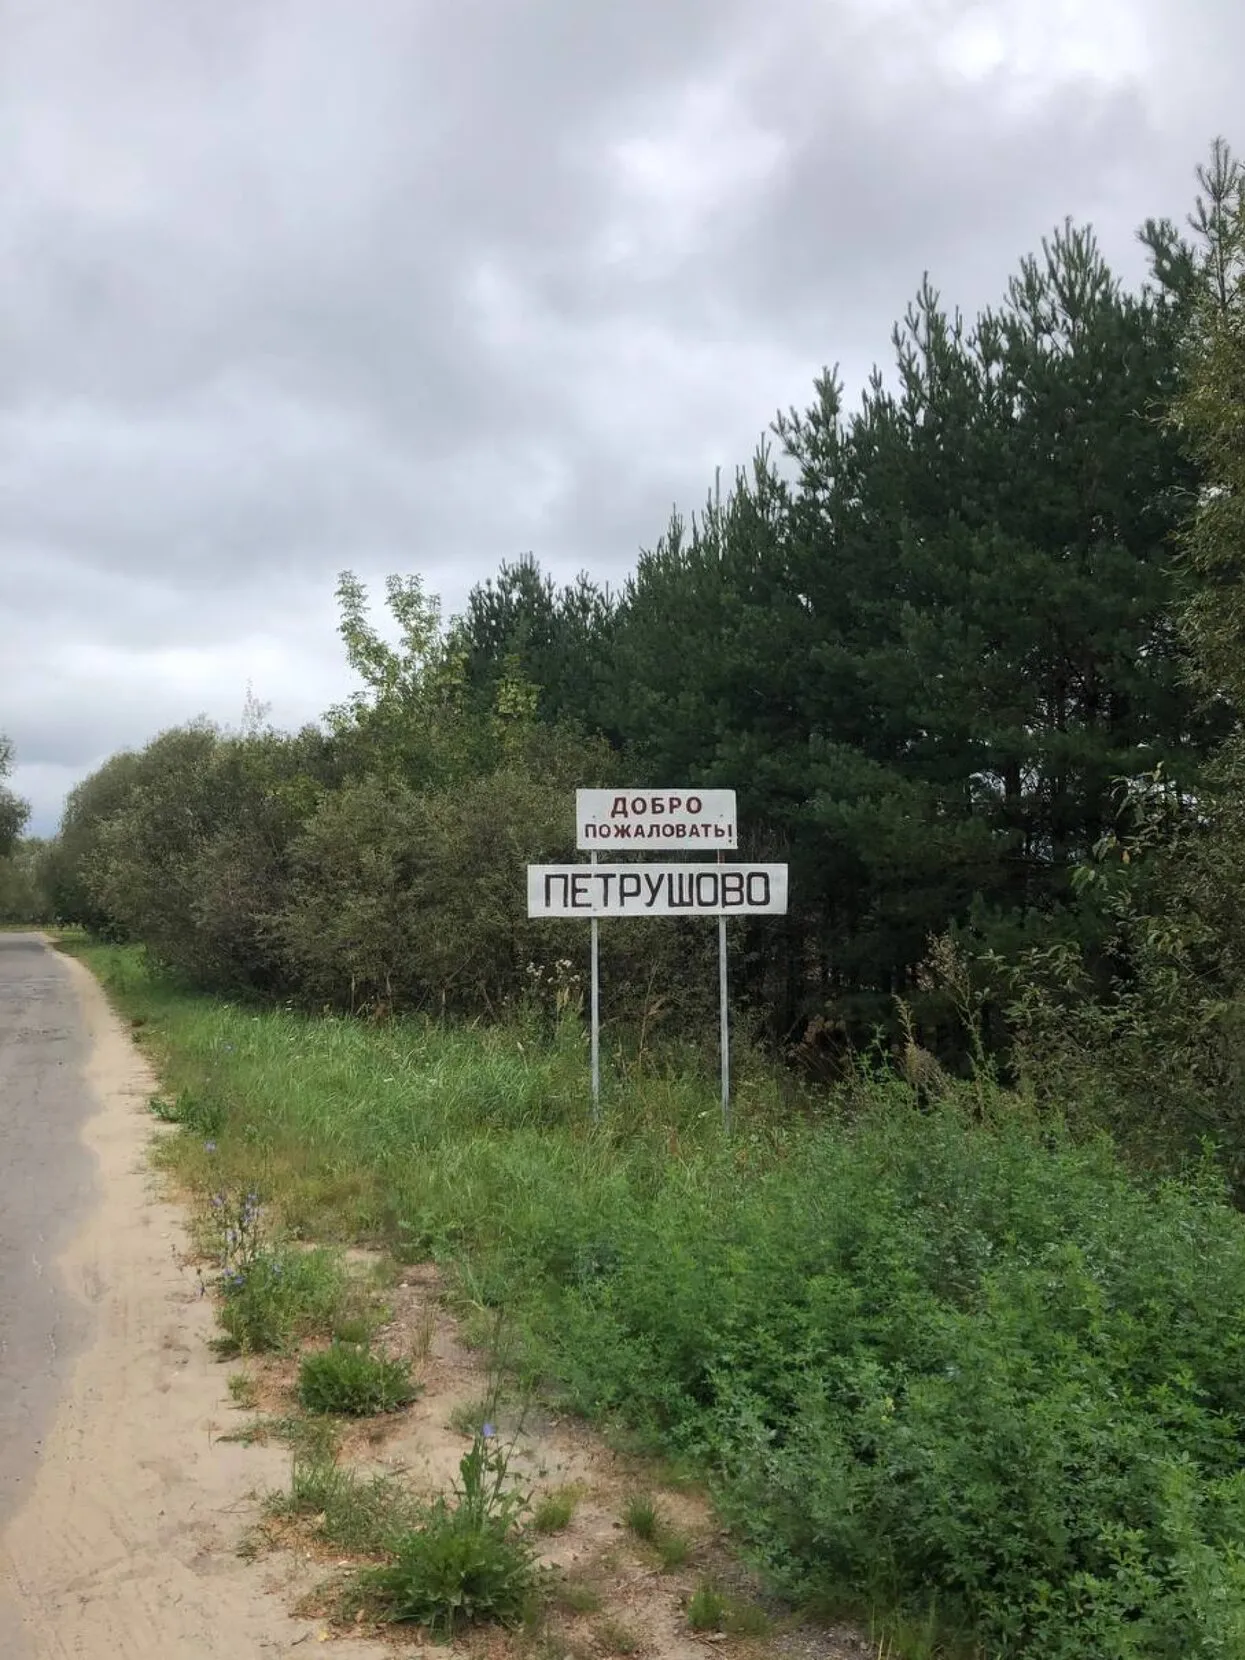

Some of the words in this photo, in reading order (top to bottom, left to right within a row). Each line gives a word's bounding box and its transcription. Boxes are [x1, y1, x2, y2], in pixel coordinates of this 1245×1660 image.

[611, 797, 702, 818] ДОБРО
[585, 823, 733, 843] ПОЖАЛОВАТЬ!
[544, 872, 771, 908] ПЕТРУШОВО
